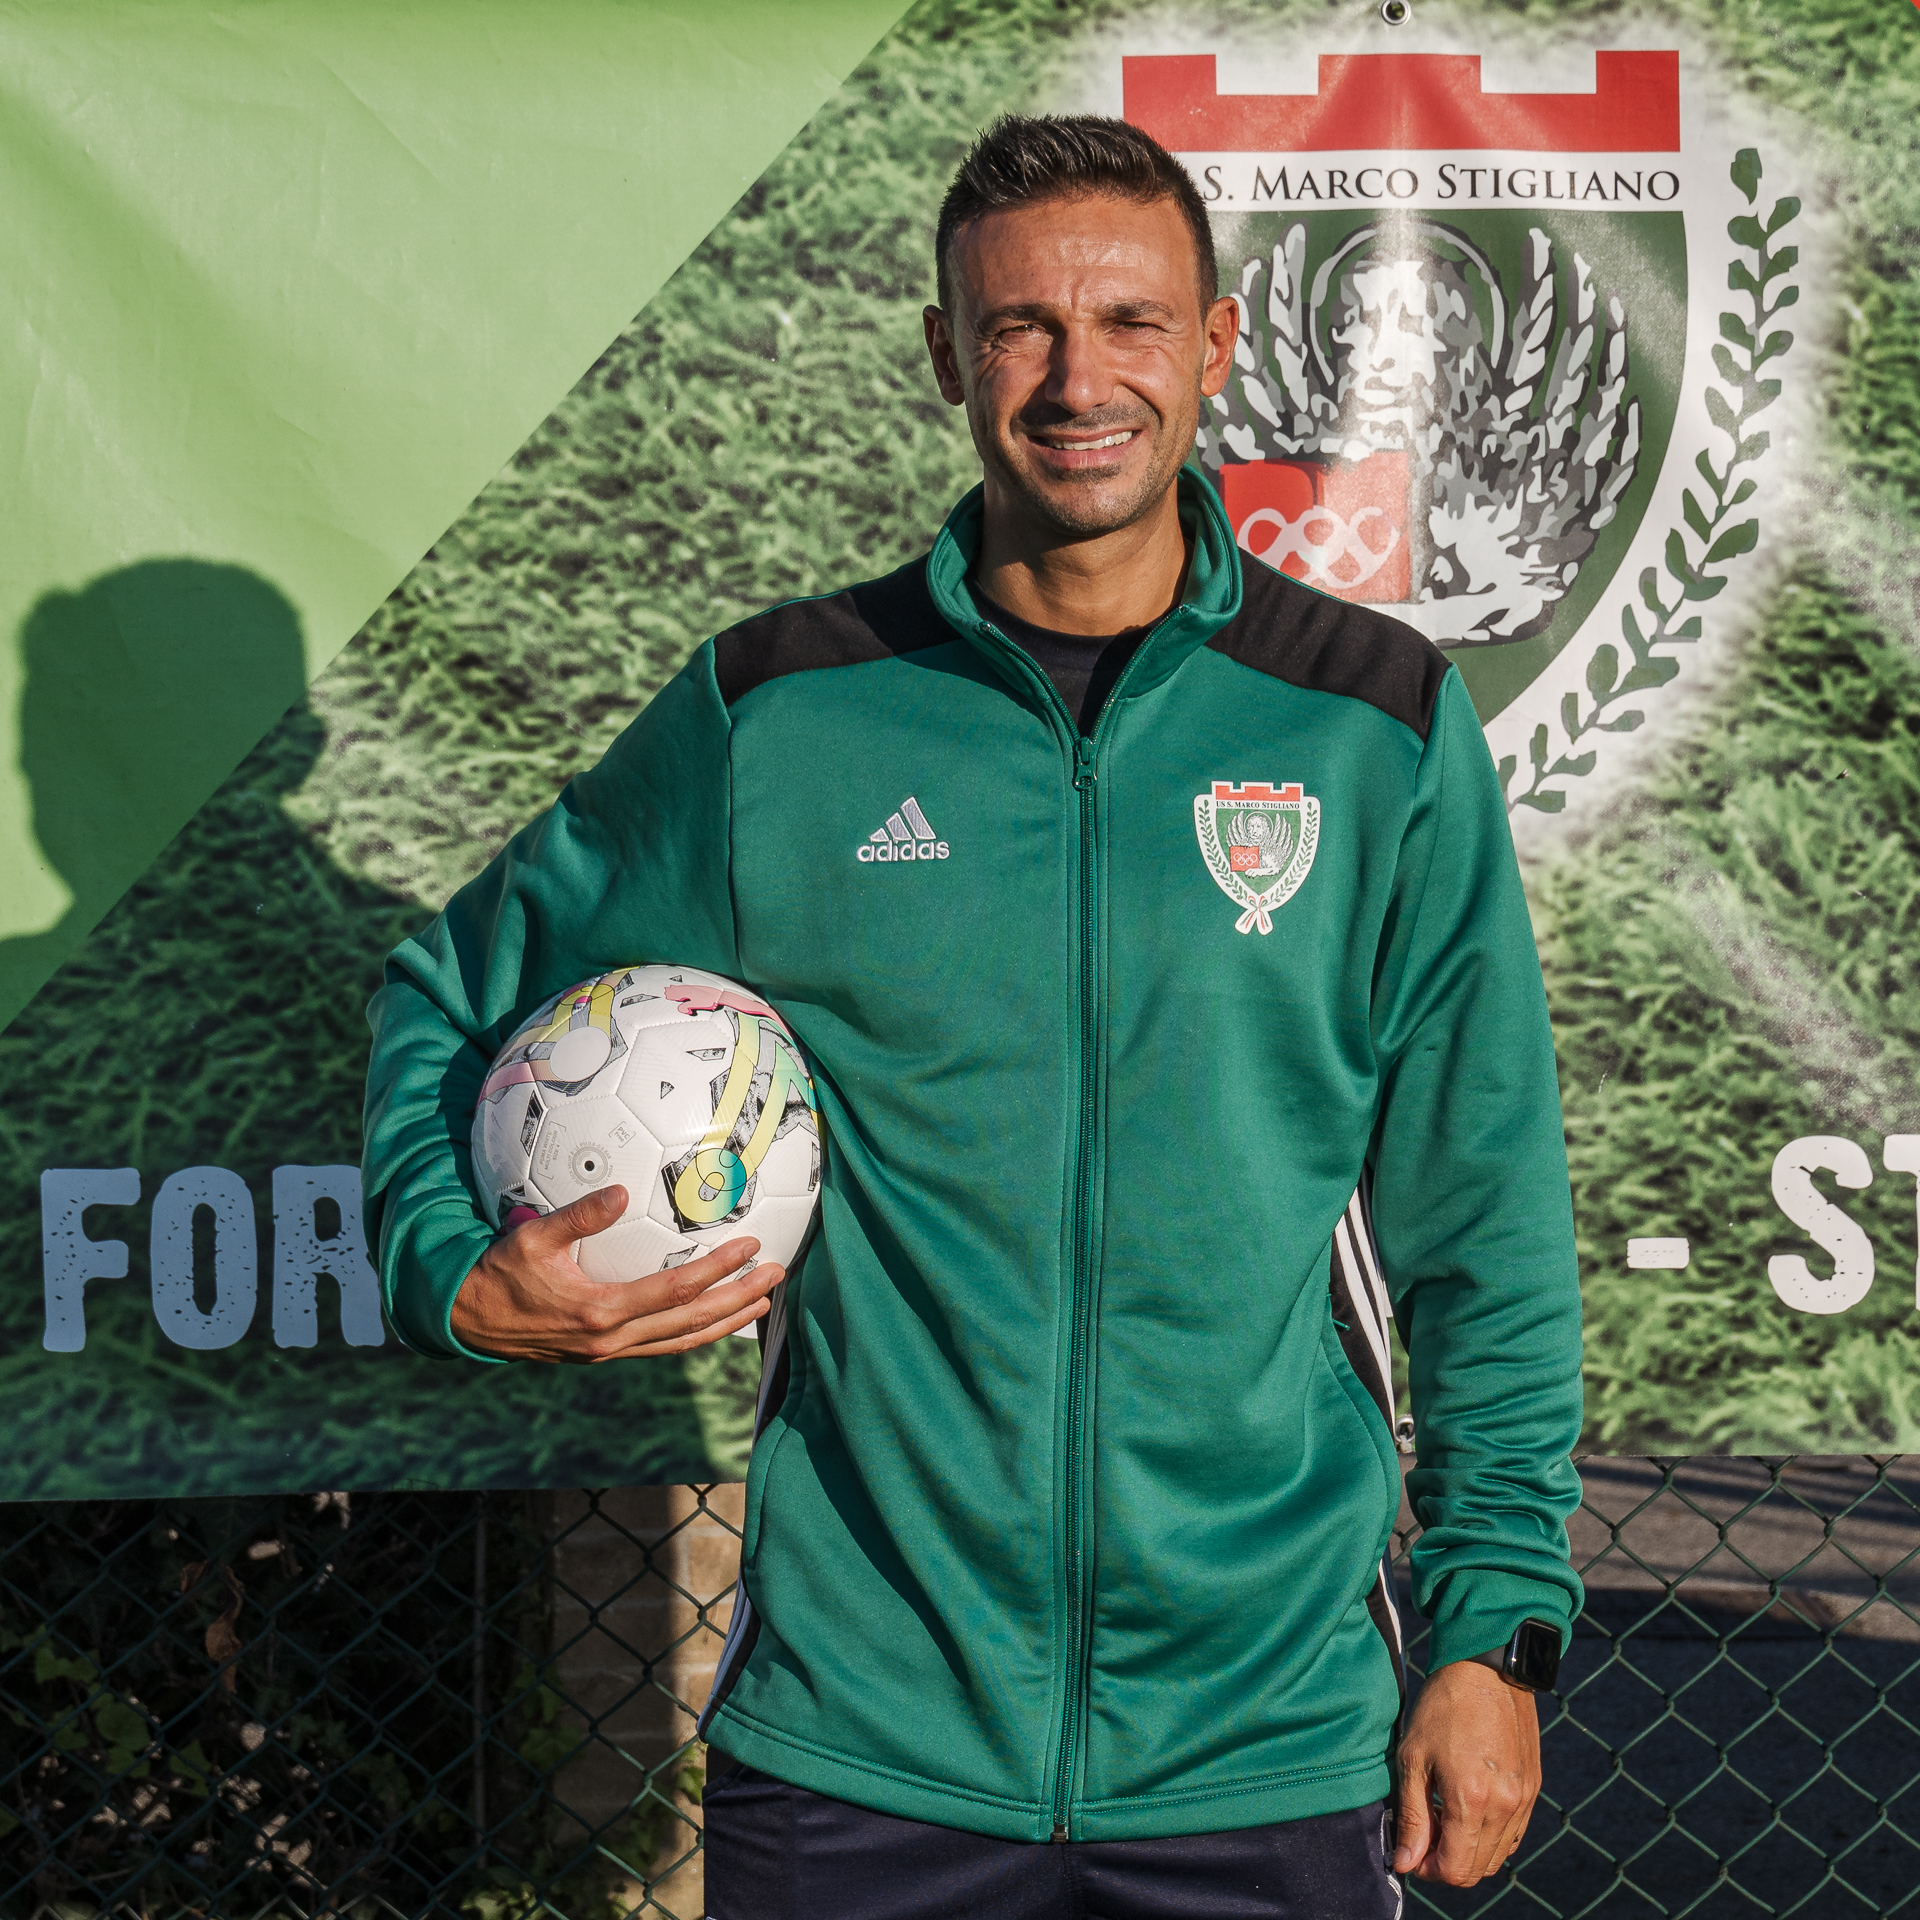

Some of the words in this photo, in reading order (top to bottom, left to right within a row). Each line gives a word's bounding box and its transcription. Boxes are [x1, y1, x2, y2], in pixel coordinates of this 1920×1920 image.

[1203, 165, 1234, 202] S.
[1250, 165, 1419, 202] MARCO
[1436, 162, 1681, 202] STIGLIANO
[1234, 801, 1260, 809] MARCO
[1261, 802, 1300, 810] STIGLIANO
[856, 839, 950, 862] adidas
[617, 1126, 630, 1140] PVC
